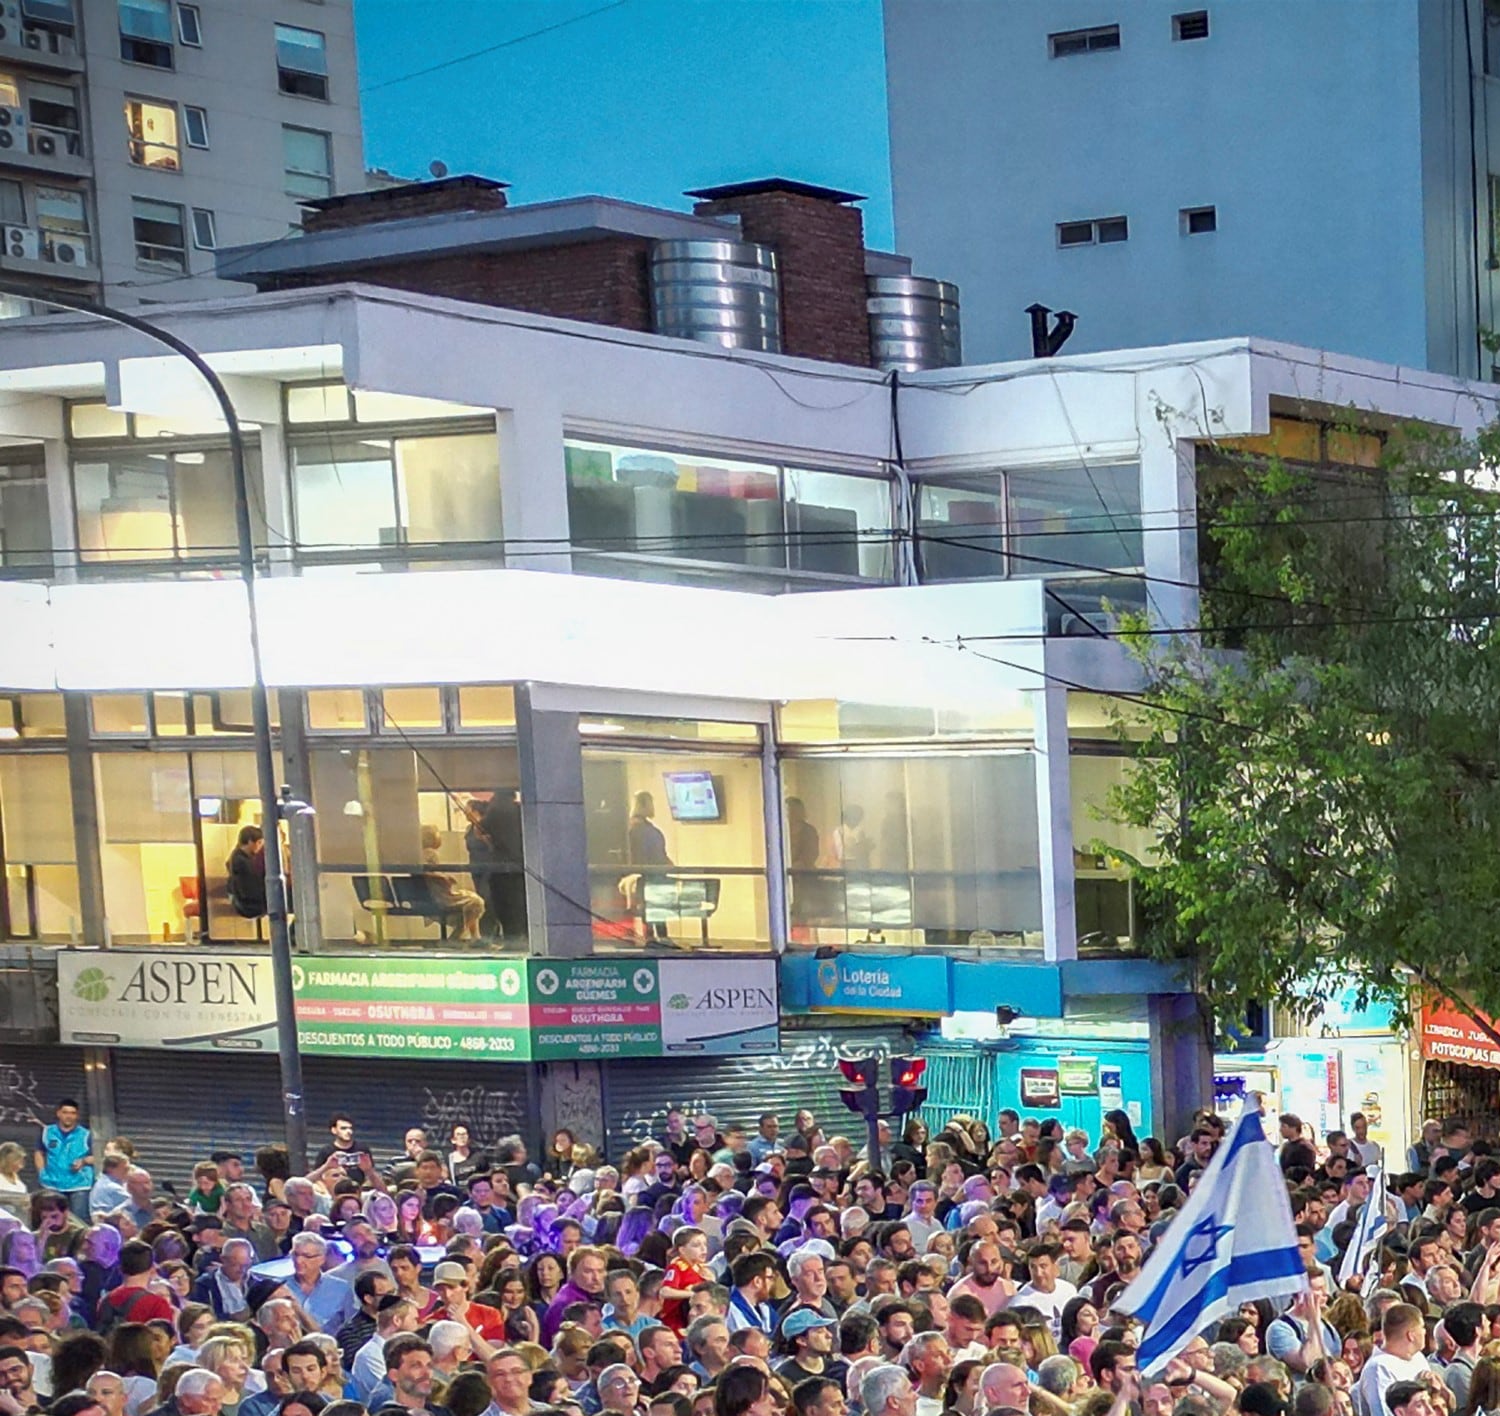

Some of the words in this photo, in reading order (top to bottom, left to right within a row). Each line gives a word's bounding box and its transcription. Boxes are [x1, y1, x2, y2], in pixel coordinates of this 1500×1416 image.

[308, 971, 370, 987] FARMACIA
[571, 966, 620, 977] FARMACIA
[842, 967, 890, 985] Lotería
[116, 960, 259, 1005] ASPEN
[695, 988, 775, 1010] ASPEN
[868, 986, 902, 998] Ciudad
[298, 1031, 365, 1046] DESCUENTOS
[368, 1036, 375, 1046] A
[376, 1035, 405, 1047] TODO
[407, 1032, 451, 1049] PÚBLICO
[539, 1034, 593, 1045] DESCUENTOS
[1431, 1042, 1489, 1063] FOTOCOPIAS
